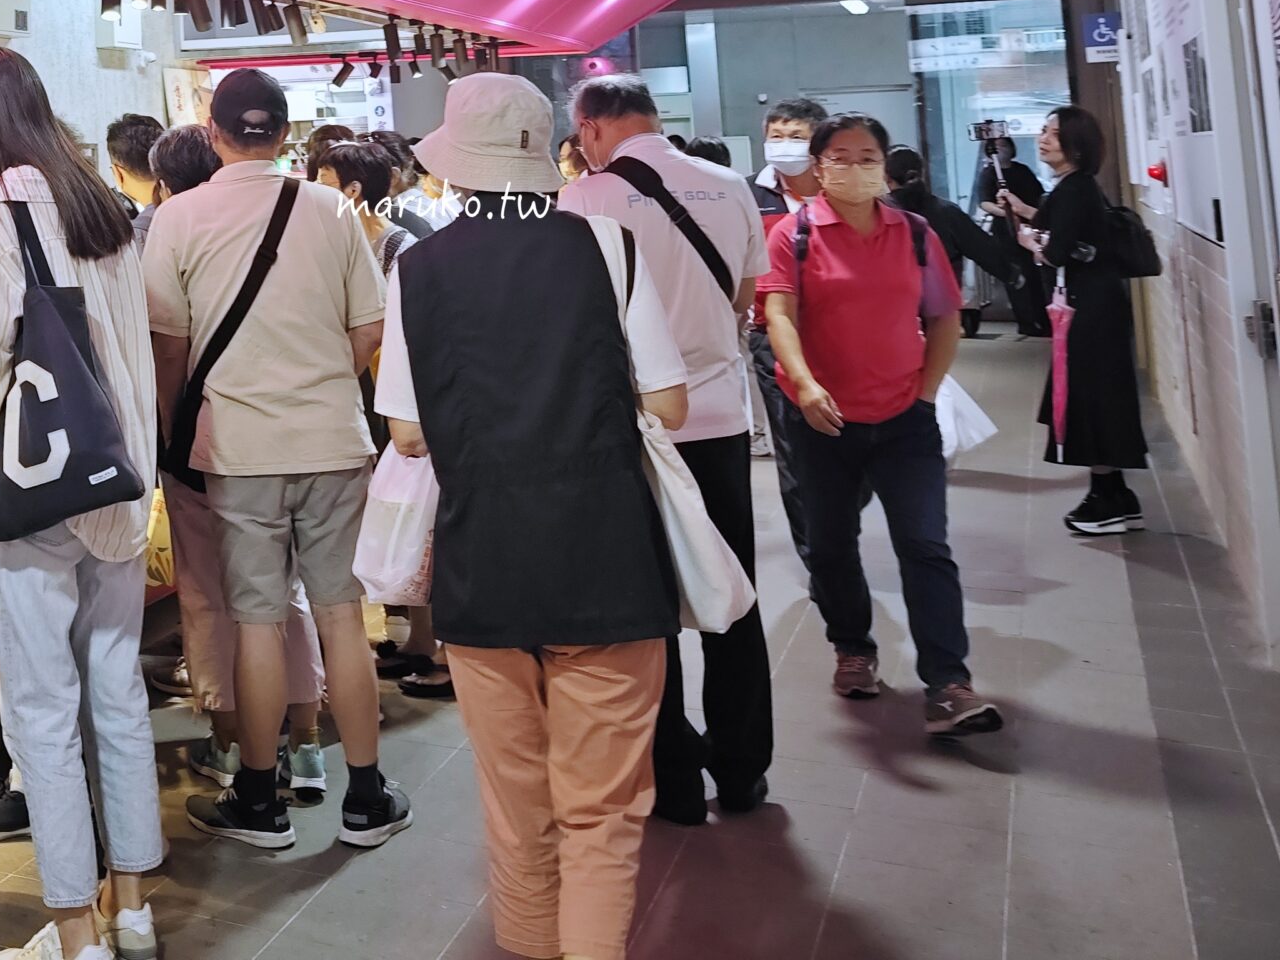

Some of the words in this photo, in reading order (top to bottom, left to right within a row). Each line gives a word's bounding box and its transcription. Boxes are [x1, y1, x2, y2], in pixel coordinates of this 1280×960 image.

[627, 190, 679, 208] PIG
[684, 190, 727, 201] GOLF
[2, 359, 71, 490] C
